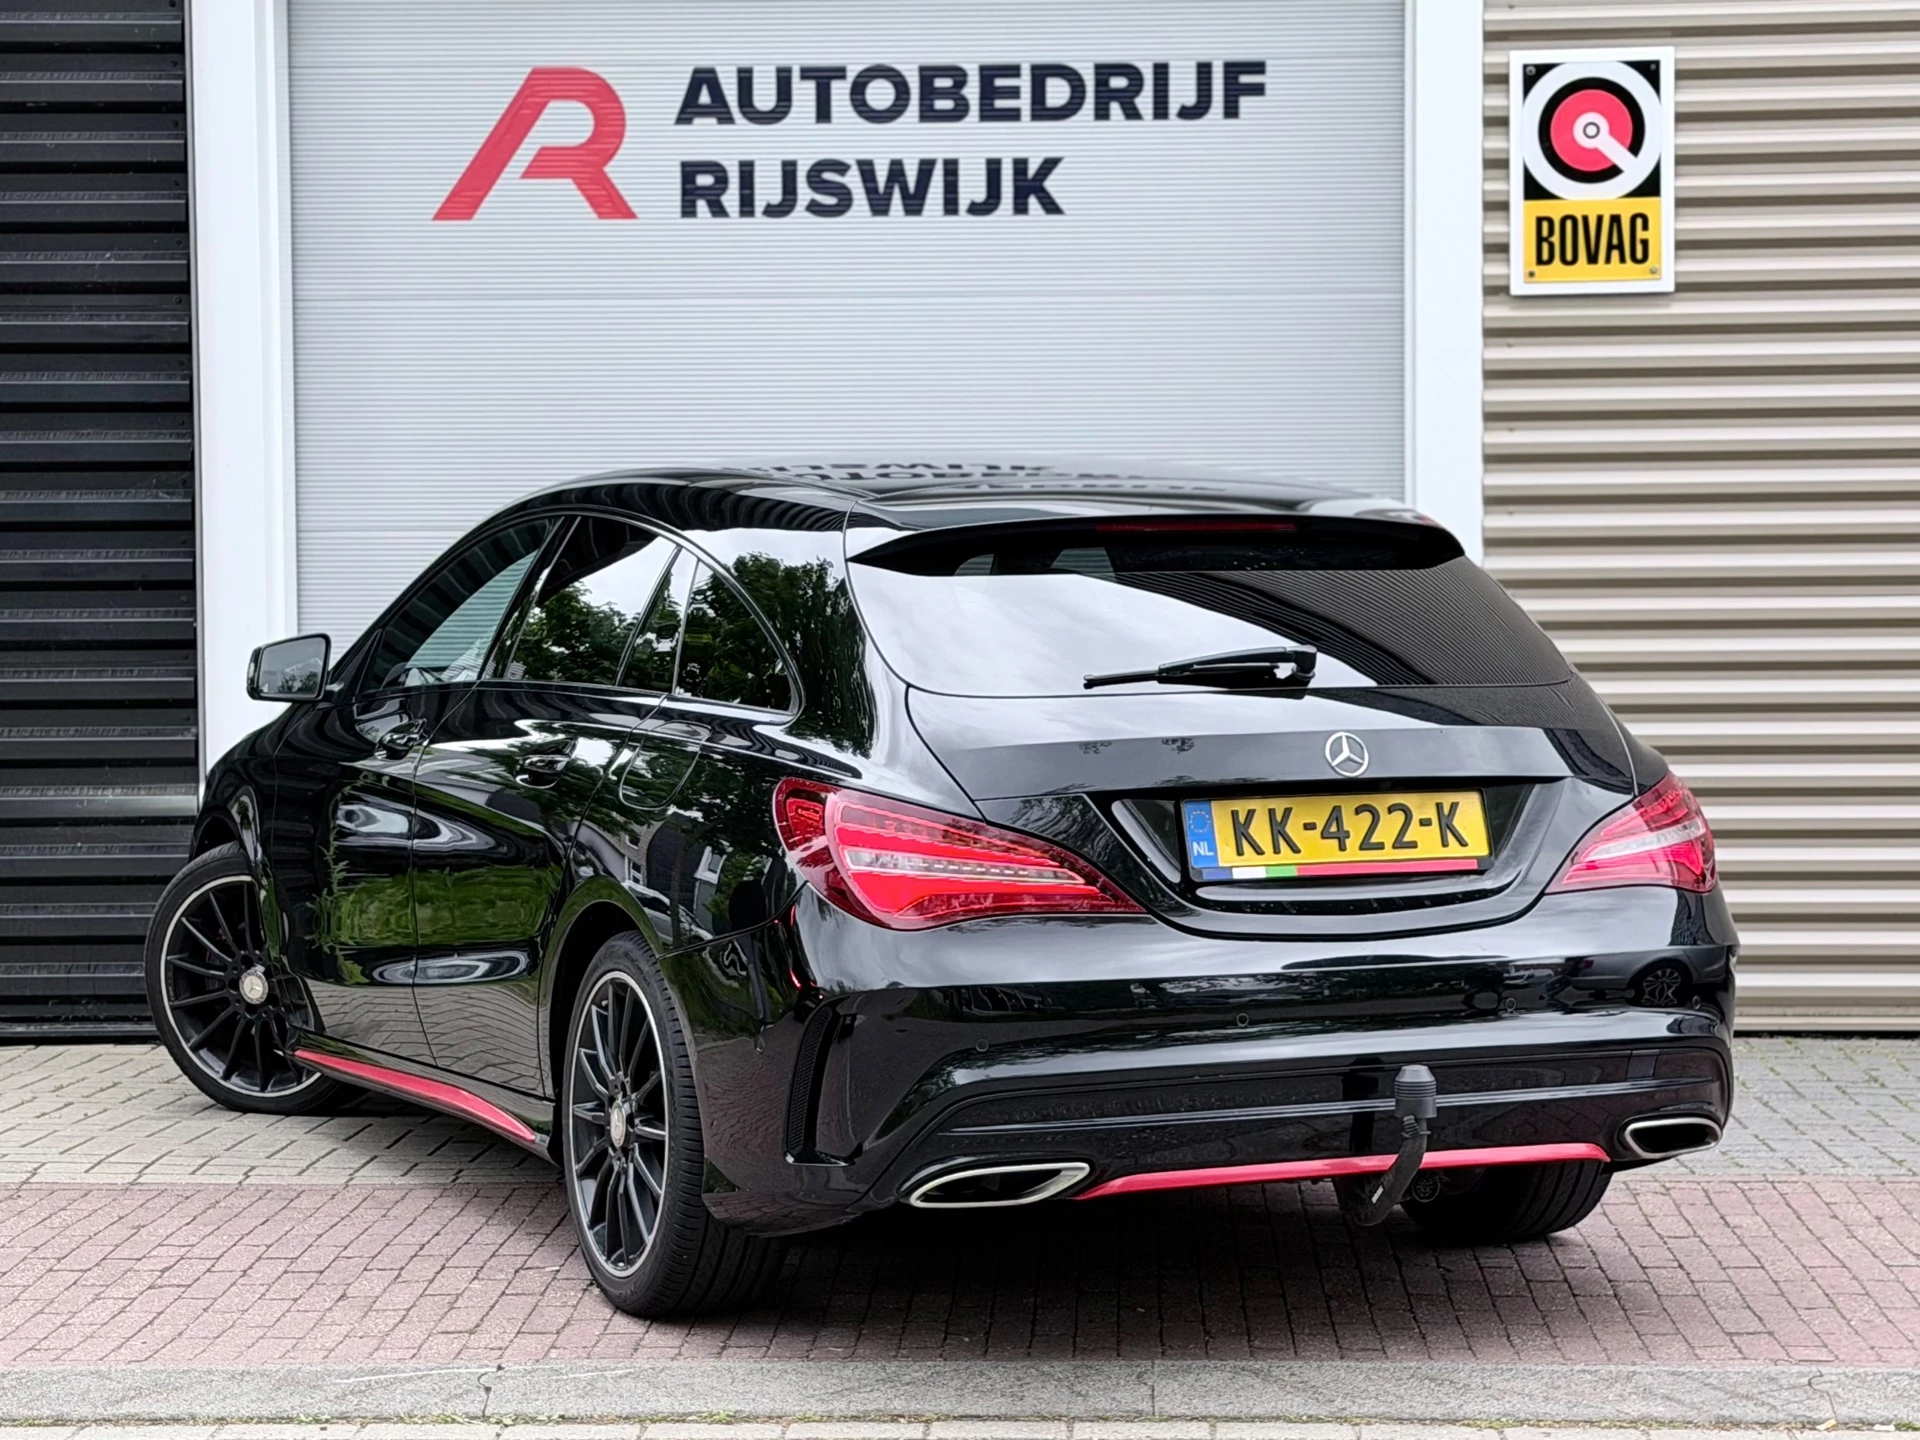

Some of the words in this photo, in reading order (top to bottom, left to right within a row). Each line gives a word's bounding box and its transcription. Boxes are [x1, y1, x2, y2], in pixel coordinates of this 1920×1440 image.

[675, 61, 1266, 125] AUTOBEDRIJF
[680, 157, 1065, 218] RIJSWIJK
[1535, 212, 1649, 266] BOVAG
[1193, 842, 1214, 856] NL
[1231, 802, 1469, 856] KK-422-K
